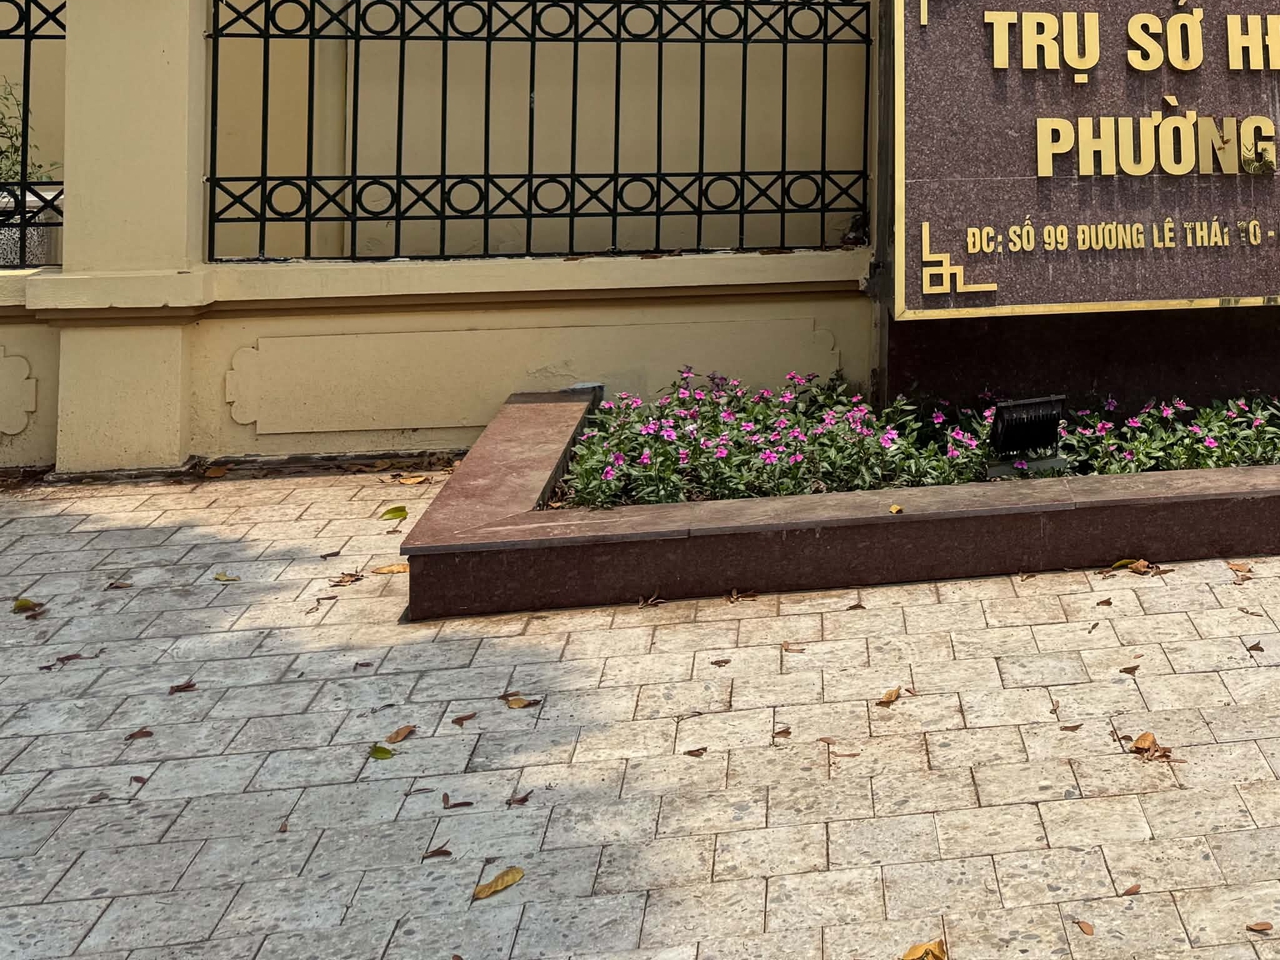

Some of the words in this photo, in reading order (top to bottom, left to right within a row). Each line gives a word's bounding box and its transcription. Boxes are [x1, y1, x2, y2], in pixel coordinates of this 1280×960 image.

[984, 10, 1100, 84] TRỤ
[1036, 95, 1277, 177] PHƯỜNG
[966, 226, 1003, 254] ĐC:
[1008, 214, 1035, 252] SỐ
[1043, 224, 1068, 251] 99
[1153, 217, 1176, 248] LÊ
[1183, 215, 1230, 247] THÁI
